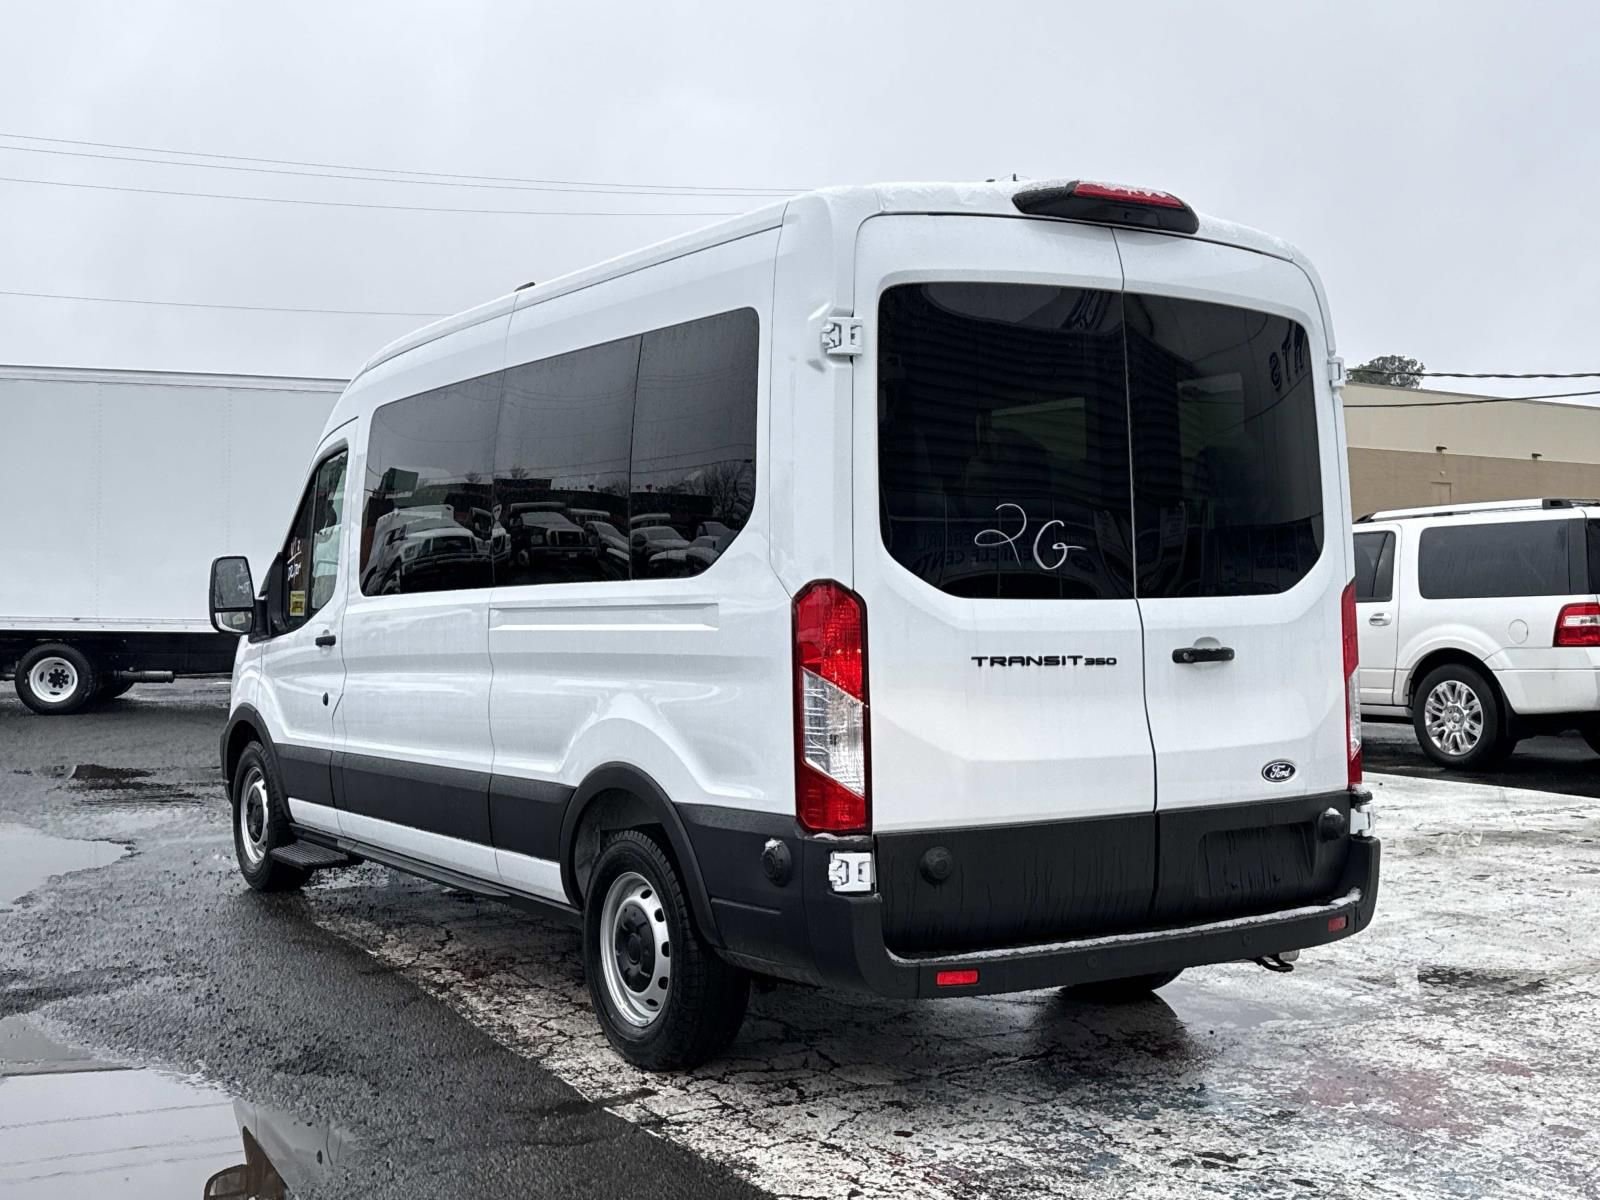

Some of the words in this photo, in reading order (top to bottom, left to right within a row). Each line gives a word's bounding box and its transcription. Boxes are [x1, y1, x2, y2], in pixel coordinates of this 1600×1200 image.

[971, 655, 1083, 667] TRANSIT
[1084, 657, 1117, 666] 350
[1267, 763, 1293, 780] Ford
